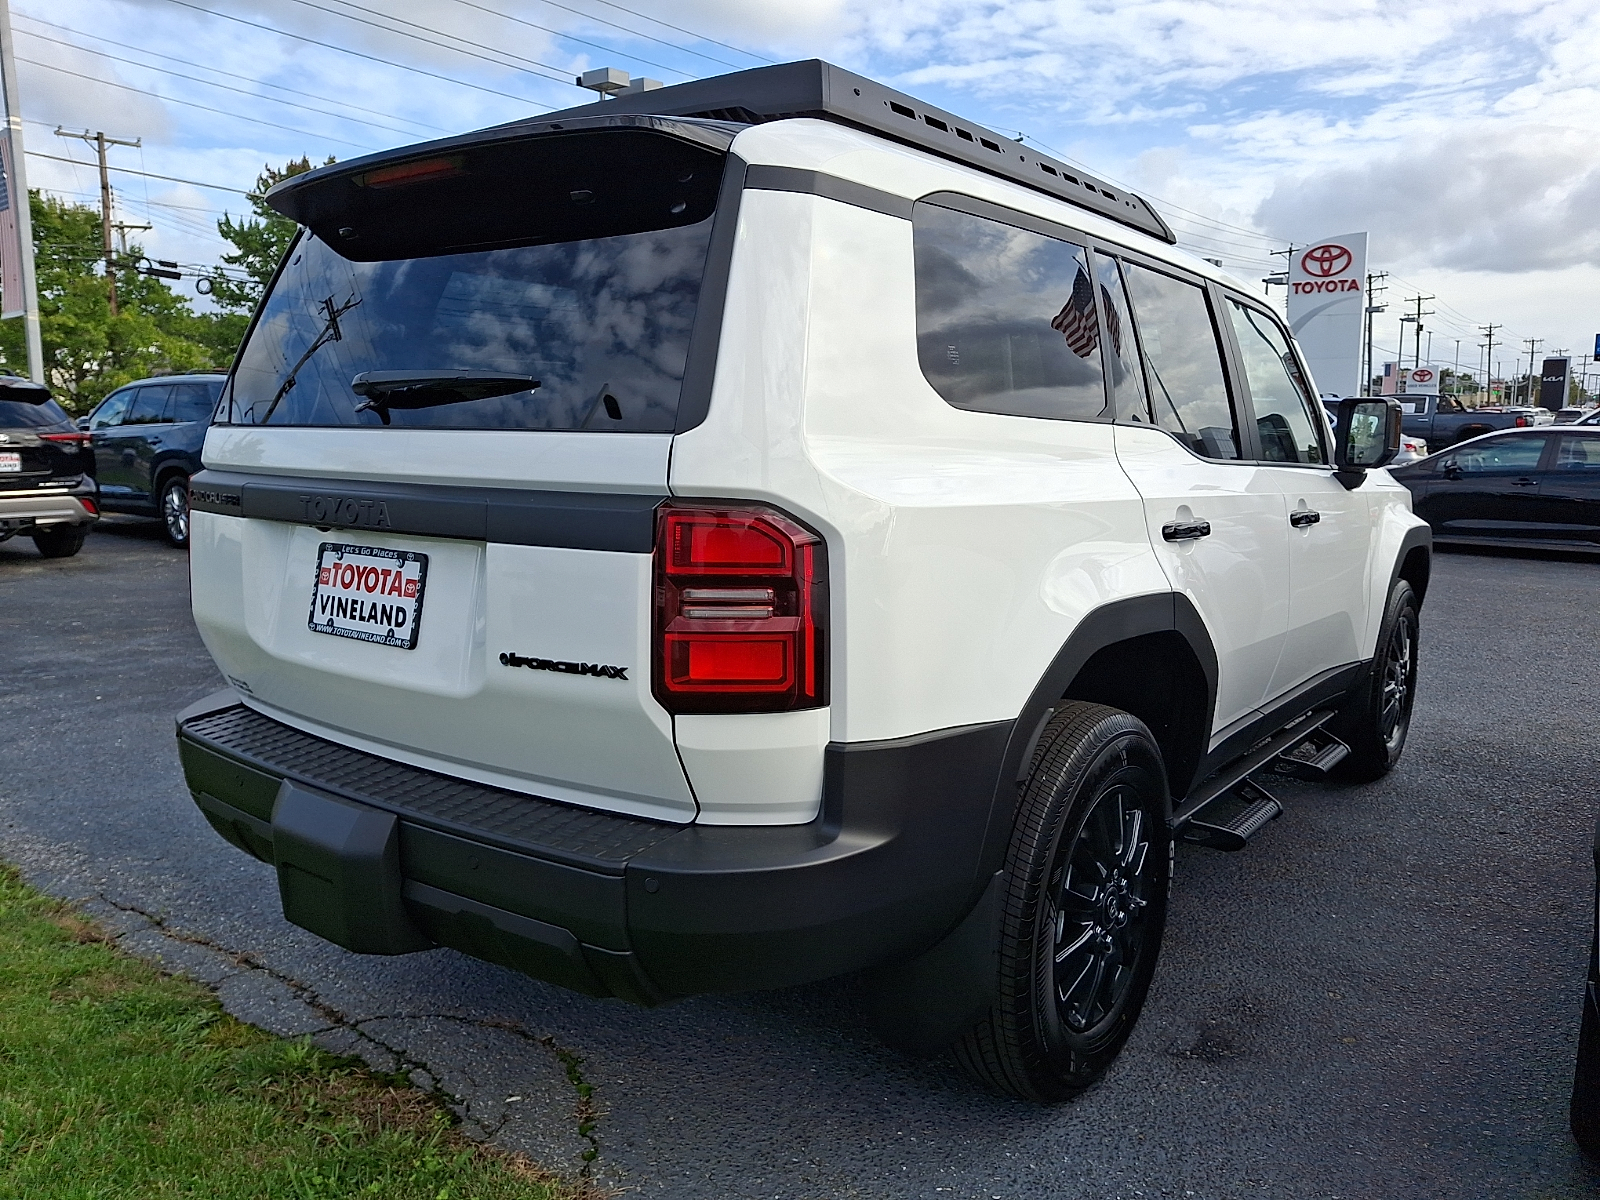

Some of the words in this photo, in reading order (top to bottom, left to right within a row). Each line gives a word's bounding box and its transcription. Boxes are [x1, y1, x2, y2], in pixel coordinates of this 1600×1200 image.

[1292, 279, 1359, 294] TOYOTA
[301, 495, 391, 528] TOYOTA
[341, 545, 360, 554] Let's
[361, 547, 370, 555] Go
[372, 549, 398, 559] Places
[332, 562, 403, 598] TOYOTA
[320, 593, 407, 629] VINELAND
[316, 624, 402, 647] WWW.TOYOTAVINELAND.COM
